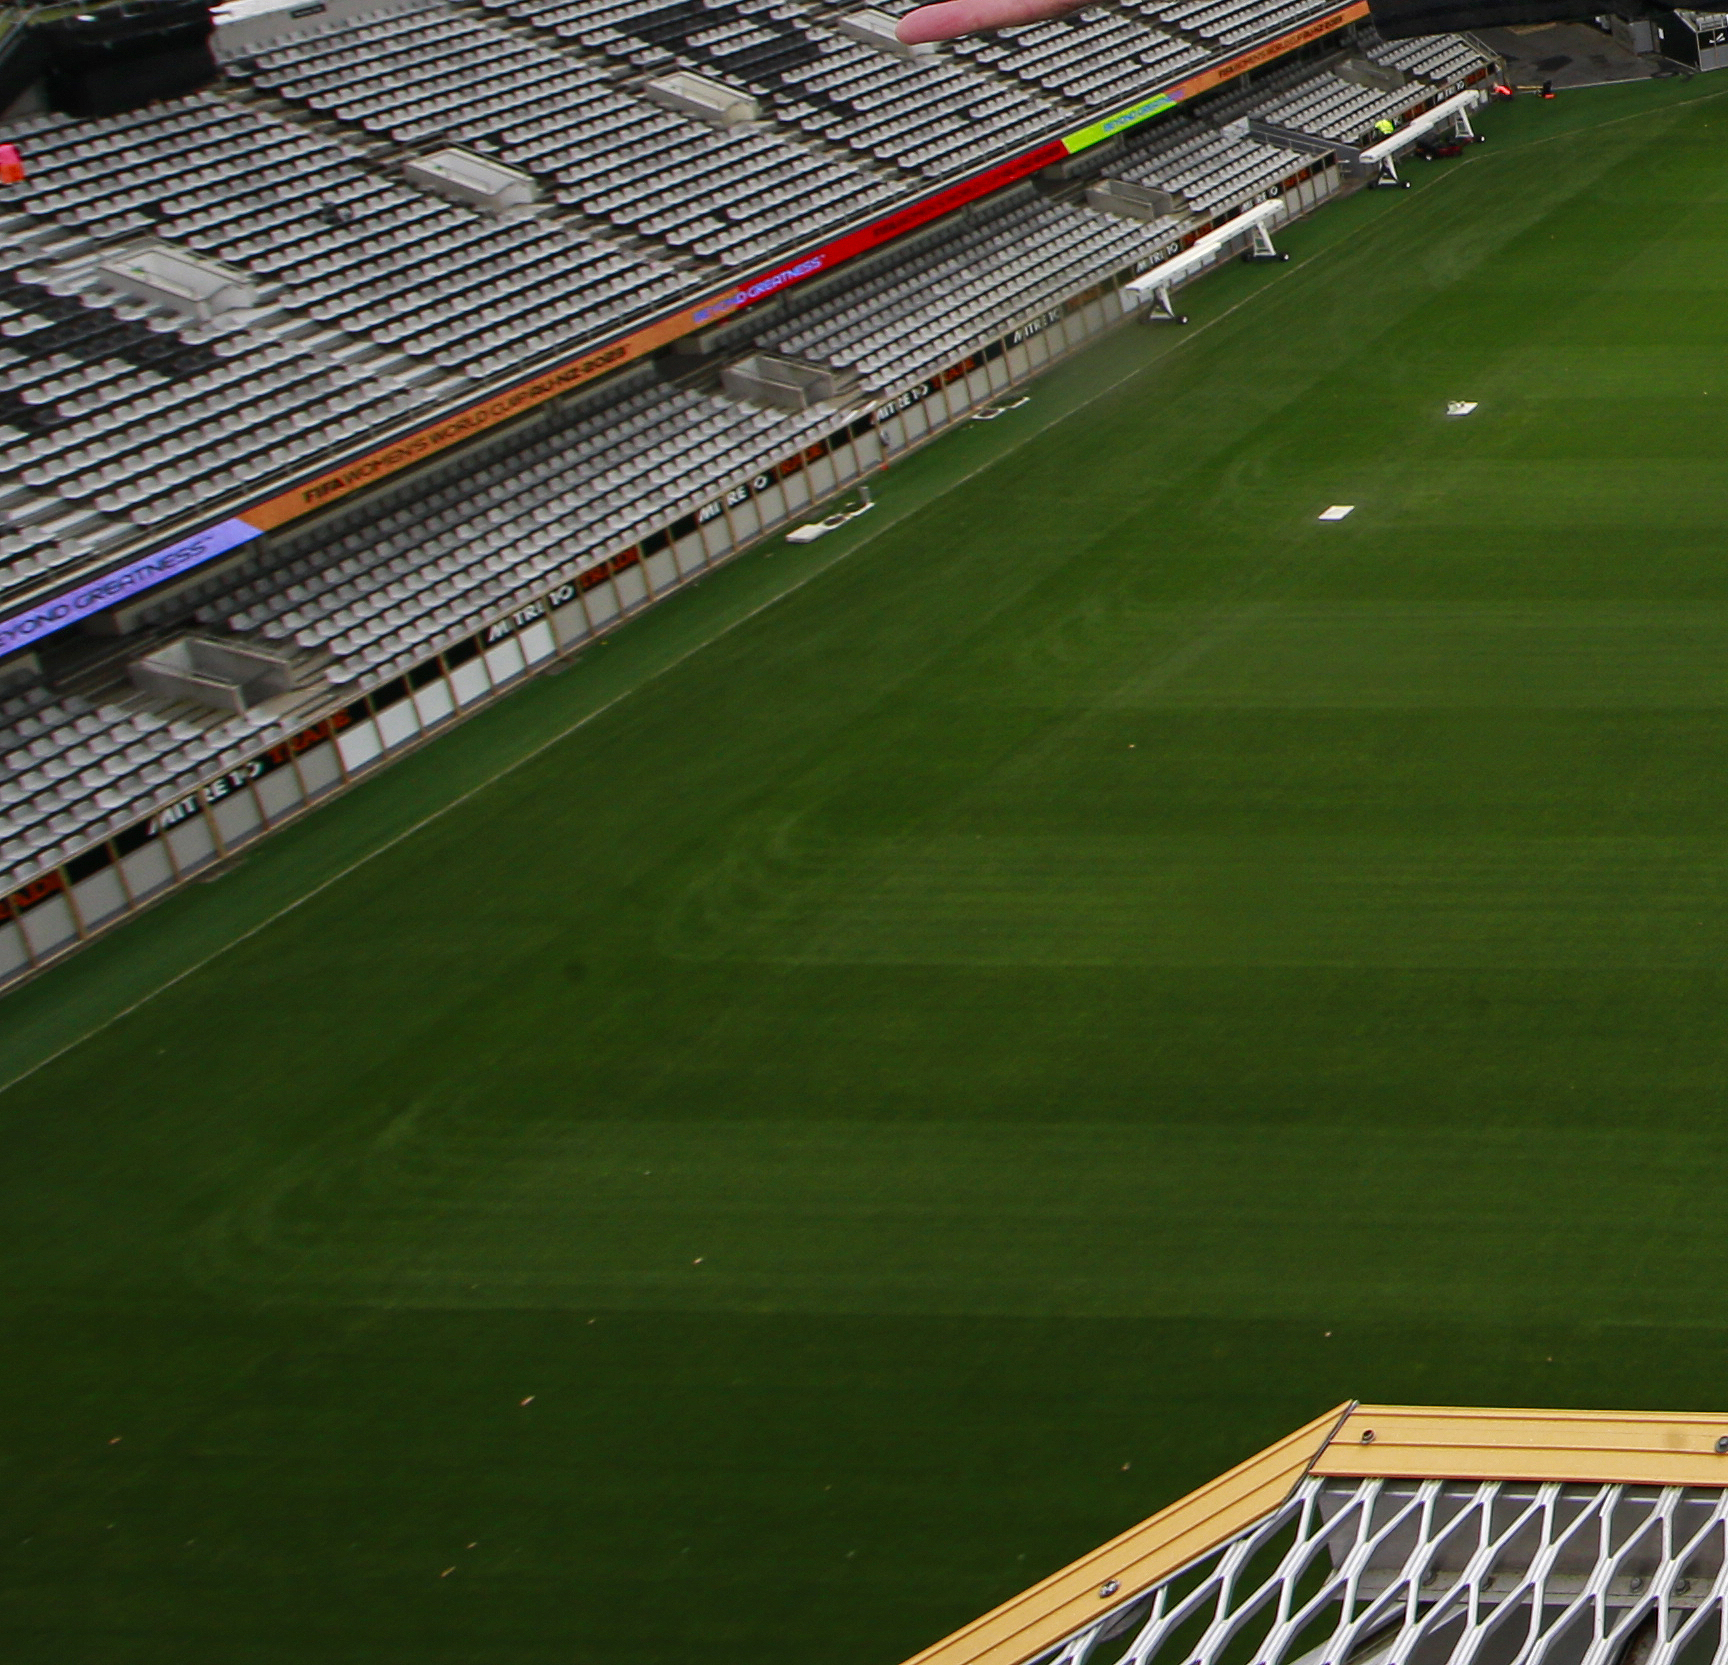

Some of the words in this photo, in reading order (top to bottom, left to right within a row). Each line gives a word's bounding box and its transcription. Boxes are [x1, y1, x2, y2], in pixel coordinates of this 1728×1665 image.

[692, 290, 748, 324] BEYOND
[746, 256, 823, 298] GREATNESS
[1135, 250, 1164, 273] MTR
[303, 476, 345, 504] FIFA
[343, 436, 430, 485] WOMEN'S
[428, 410, 488, 446] WORLD
[487, 390, 530, 418] CUP
[697, 484, 749, 524] MIRE
[0, 603, 70, 648] YOND
[72, 539, 208, 610] GREATNESS
[486, 599, 545, 643] MTR
[547, 582, 576, 608] 10
